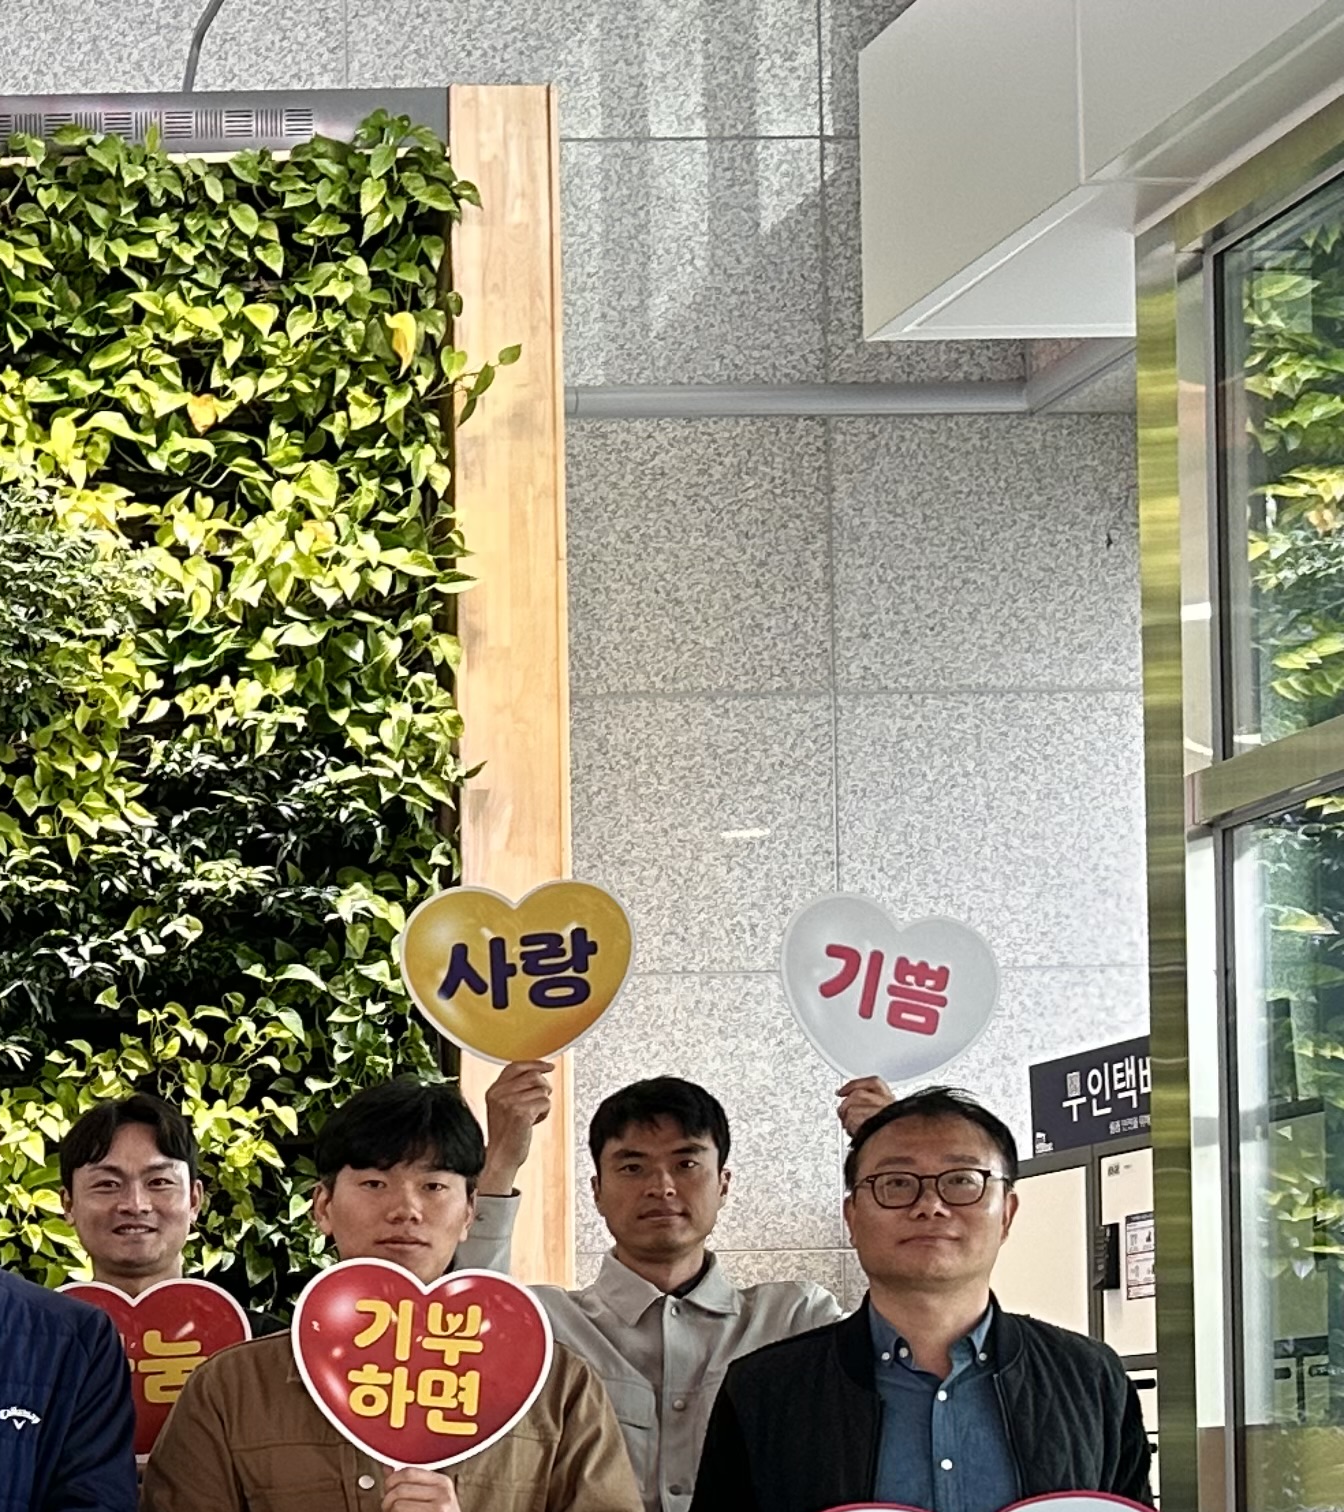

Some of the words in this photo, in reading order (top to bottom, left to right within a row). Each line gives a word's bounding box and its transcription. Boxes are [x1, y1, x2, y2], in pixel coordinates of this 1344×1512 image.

[437, 926, 598, 1010] 사랑
[819, 943, 951, 1037] 기쁨
[126, 1329, 209, 1403] 눔
[352, 1298, 484, 1367] 기부
[346, 1364, 480, 1436] 하면
